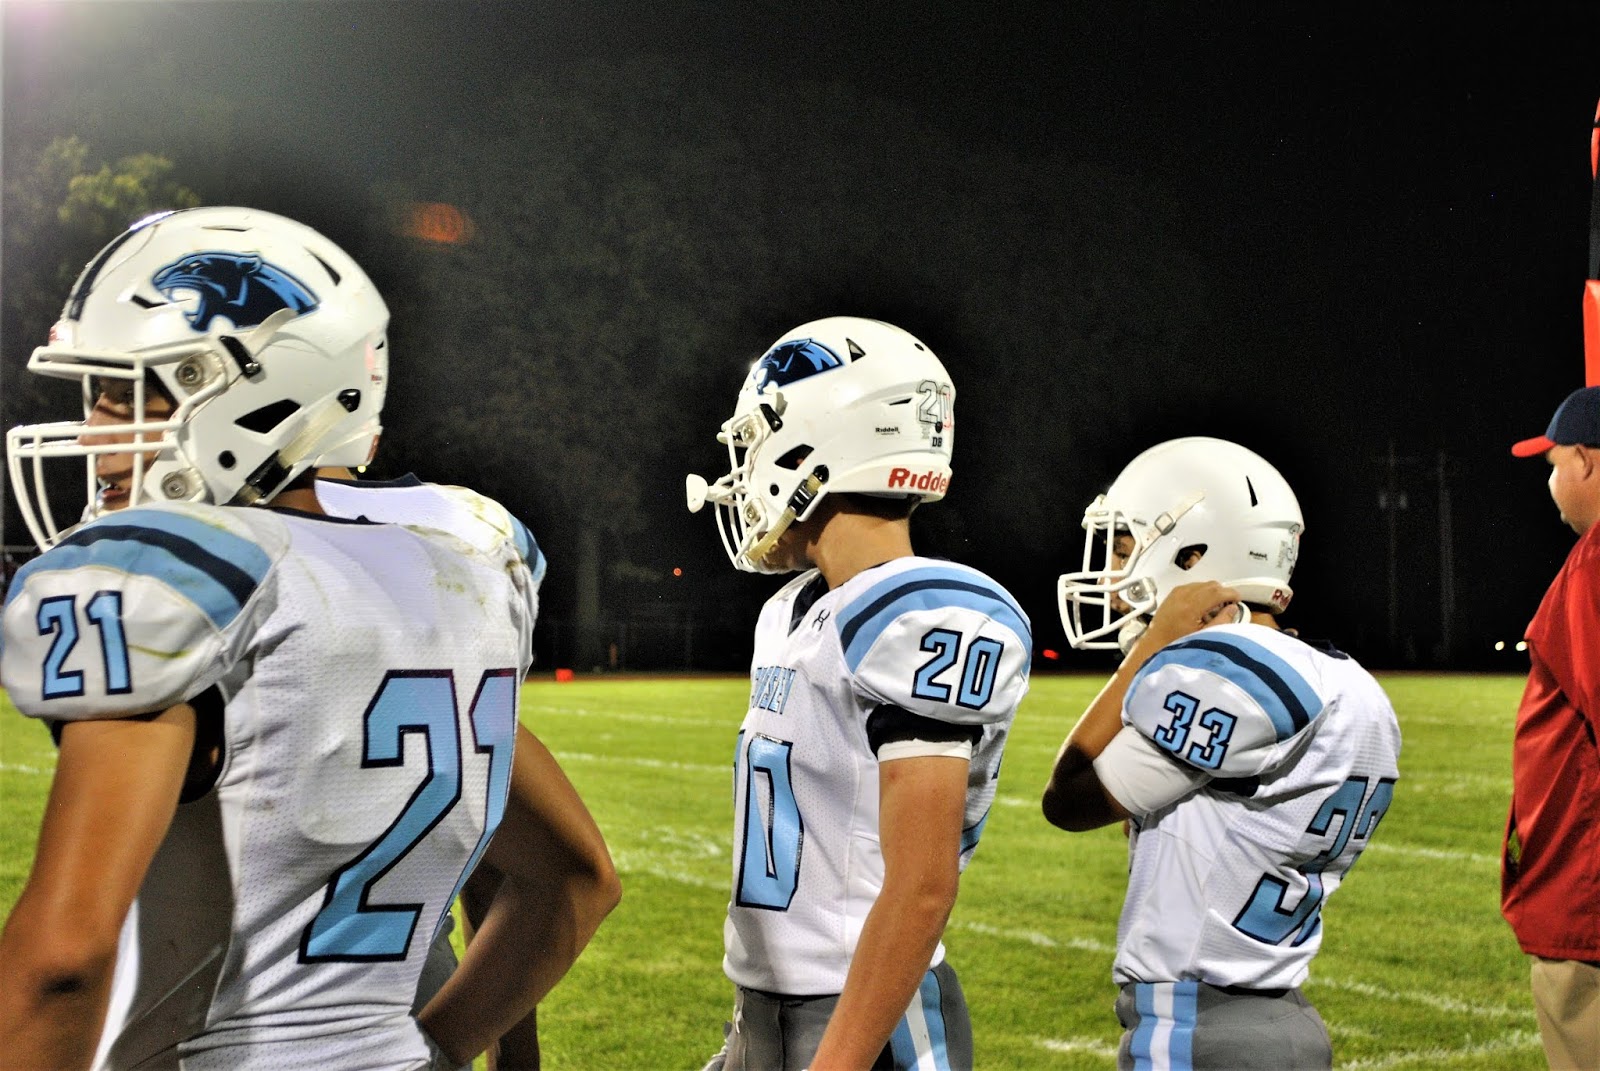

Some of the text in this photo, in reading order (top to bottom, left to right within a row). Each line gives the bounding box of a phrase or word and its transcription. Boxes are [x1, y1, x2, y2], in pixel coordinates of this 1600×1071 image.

[875, 426, 900, 434] Riddell
[37, 590, 132, 701] 21
[911, 628, 1005, 711] 20
[1154, 690, 1238, 769] 33
[734, 729, 804, 911] 0
